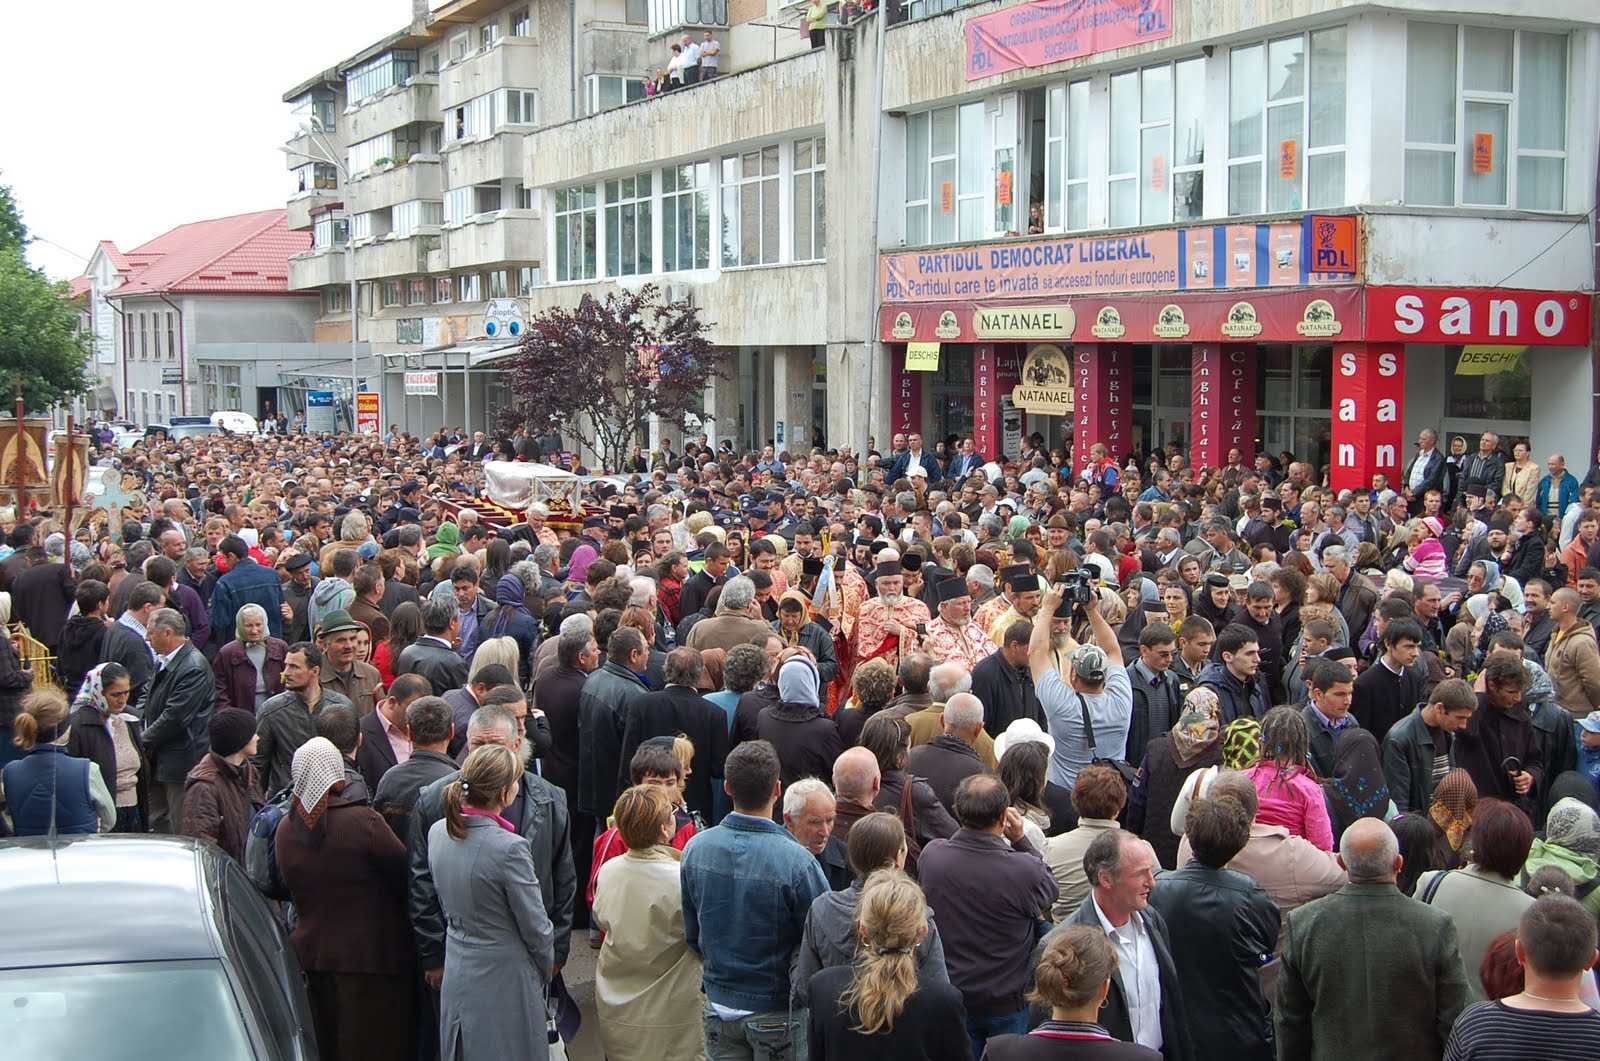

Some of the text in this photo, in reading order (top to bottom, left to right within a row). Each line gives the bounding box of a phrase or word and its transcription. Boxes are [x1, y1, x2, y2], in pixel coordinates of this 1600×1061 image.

[1138, 10, 1166, 34] PDL
[1044, 39, 1079, 58] SUCEAVA
[972, 51, 993, 70] PDL
[919, 237, 1155, 274] PARTIDUL DEMOCRAT LIBERAL,
[1317, 249, 1349, 267] PDL
[886, 282, 905, 298] PDL
[908, 278, 951, 297] Partidul
[954, 281, 981, 295] care
[984, 276, 996, 293] te
[1054, 271, 1093, 288] accesezi
[1095, 268, 1128, 286] fonduri
[1130, 270, 1176, 287] europene
[981, 313, 1063, 330] NATANAEL
[1394, 295, 1564, 337] sano
[909, 351, 938, 360] DESCHIS
[1019, 390, 1075, 404] NATANAEL
